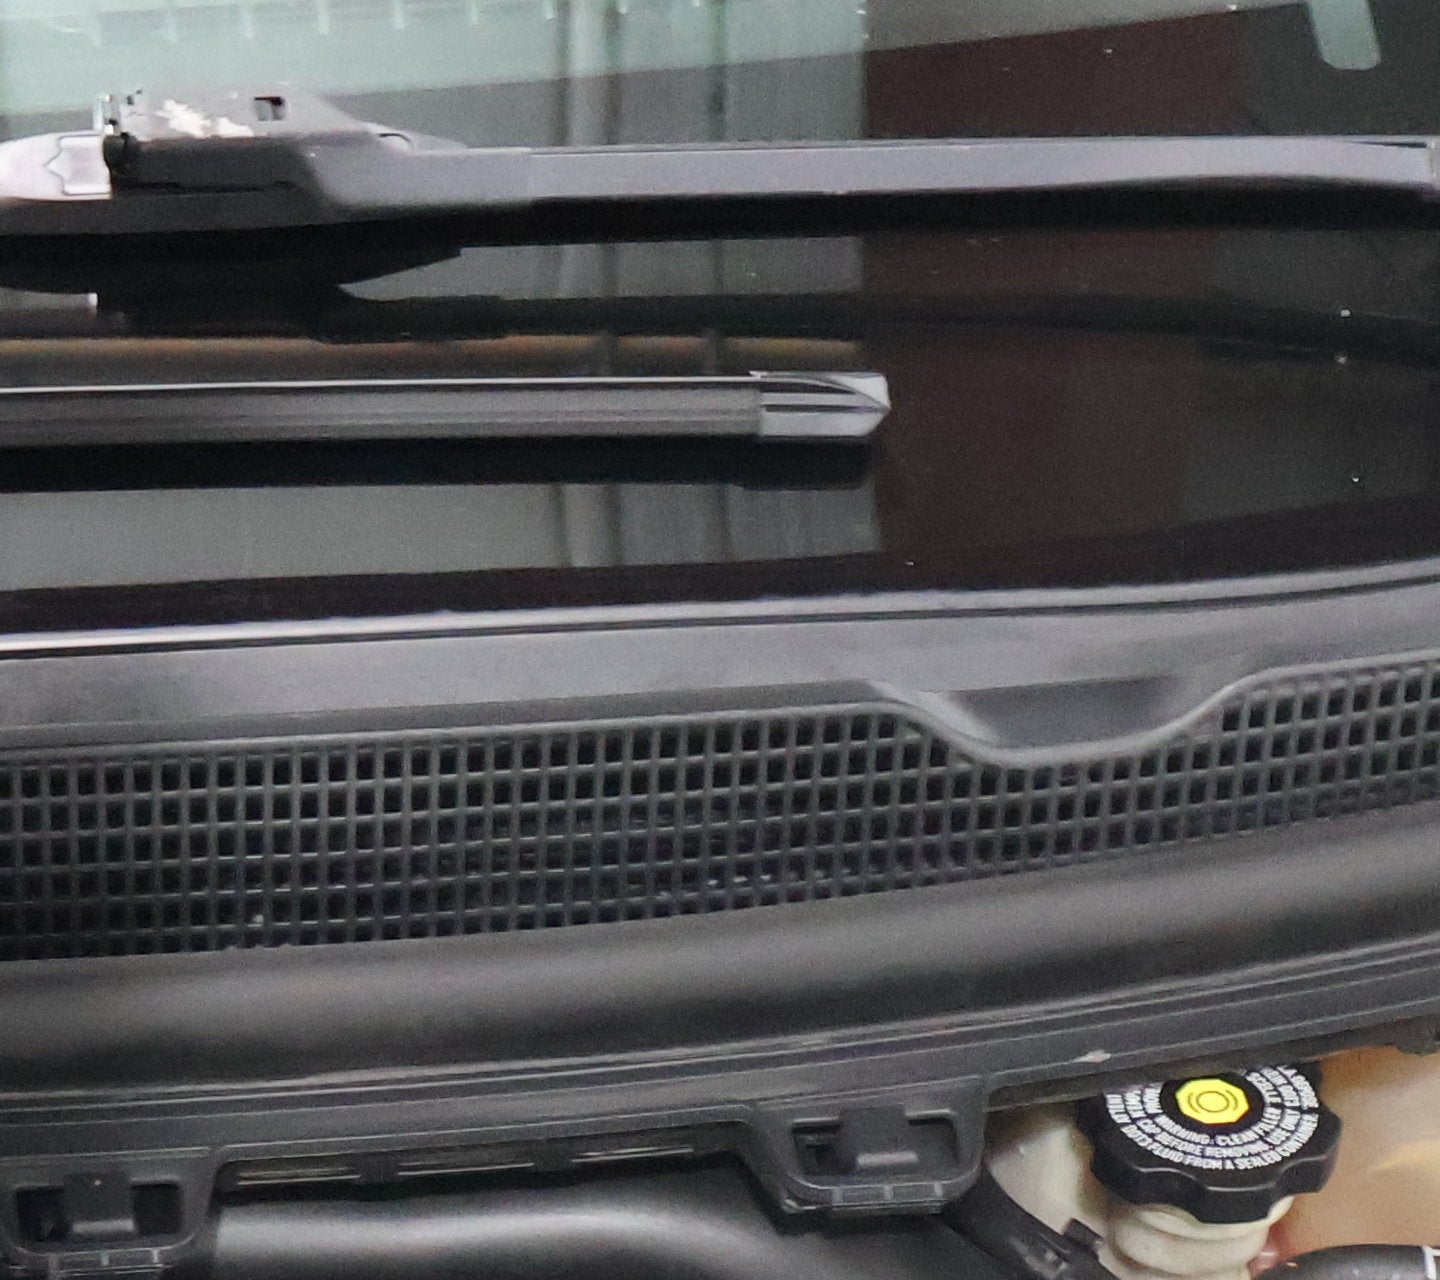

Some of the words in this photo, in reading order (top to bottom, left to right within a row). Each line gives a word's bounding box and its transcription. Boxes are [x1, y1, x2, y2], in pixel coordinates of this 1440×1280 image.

[1135, 1117, 1164, 1137] CAP
[1215, 1128, 1260, 1146] CLEAN
[1249, 1106, 1280, 1136] FILLER
[1276, 1108, 1299, 1131] ONLY
[1152, 1130, 1203, 1157] BEFORE
[1263, 1126, 1292, 1146] USE
[1144, 1142, 1185, 1163] FLUID
[1181, 1155, 1223, 1170] FROM
[1223, 1159, 1235, 1170] A
[1234, 1150, 1283, 1170] SEALED
